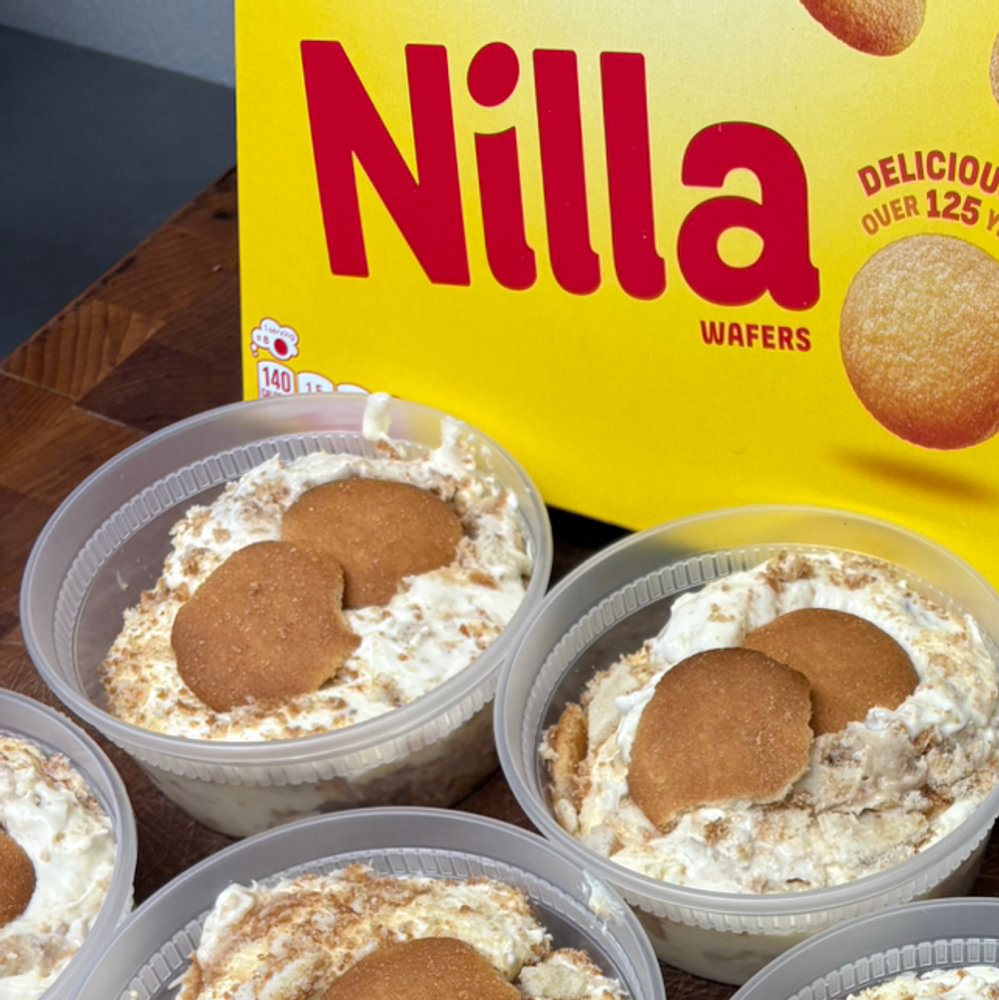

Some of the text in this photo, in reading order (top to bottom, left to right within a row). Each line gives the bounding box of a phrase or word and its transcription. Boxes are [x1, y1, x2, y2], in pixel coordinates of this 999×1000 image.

[300, 40, 820, 311] Nilla
[861, 195, 920, 236] OVER
[926, 189, 982, 226] 125
[700, 319, 812, 352] WAFERS
[262, 366, 291, 393] 140
